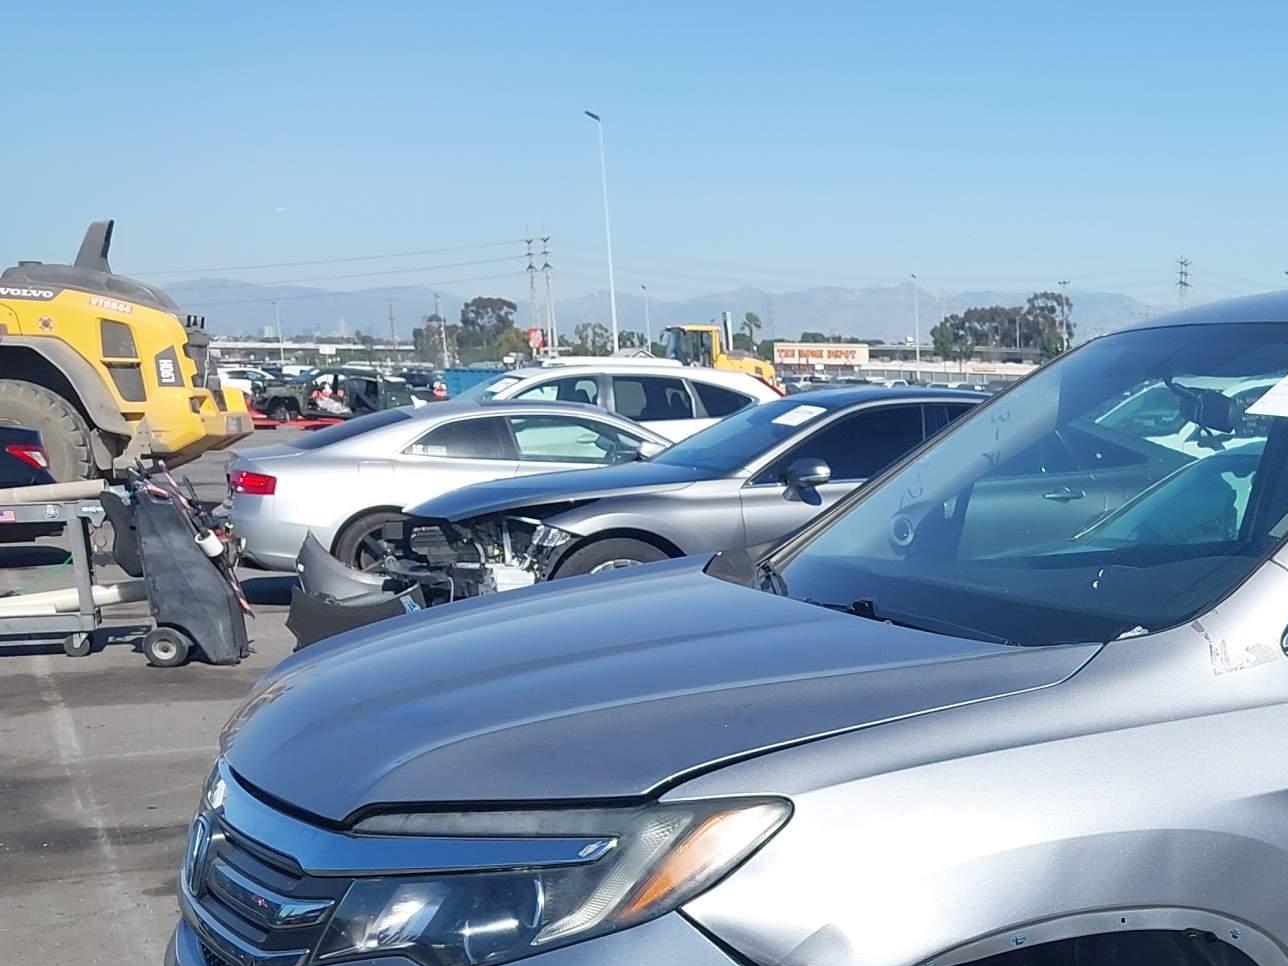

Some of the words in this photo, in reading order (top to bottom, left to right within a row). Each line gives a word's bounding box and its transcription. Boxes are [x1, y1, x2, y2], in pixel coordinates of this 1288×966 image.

[0, 288, 54, 298] VOLVO
[777, 348, 795, 359] THE
[797, 349, 824, 359] HOME
[827, 349, 856, 360] DEPOT
[159, 359, 176, 382] L90H
